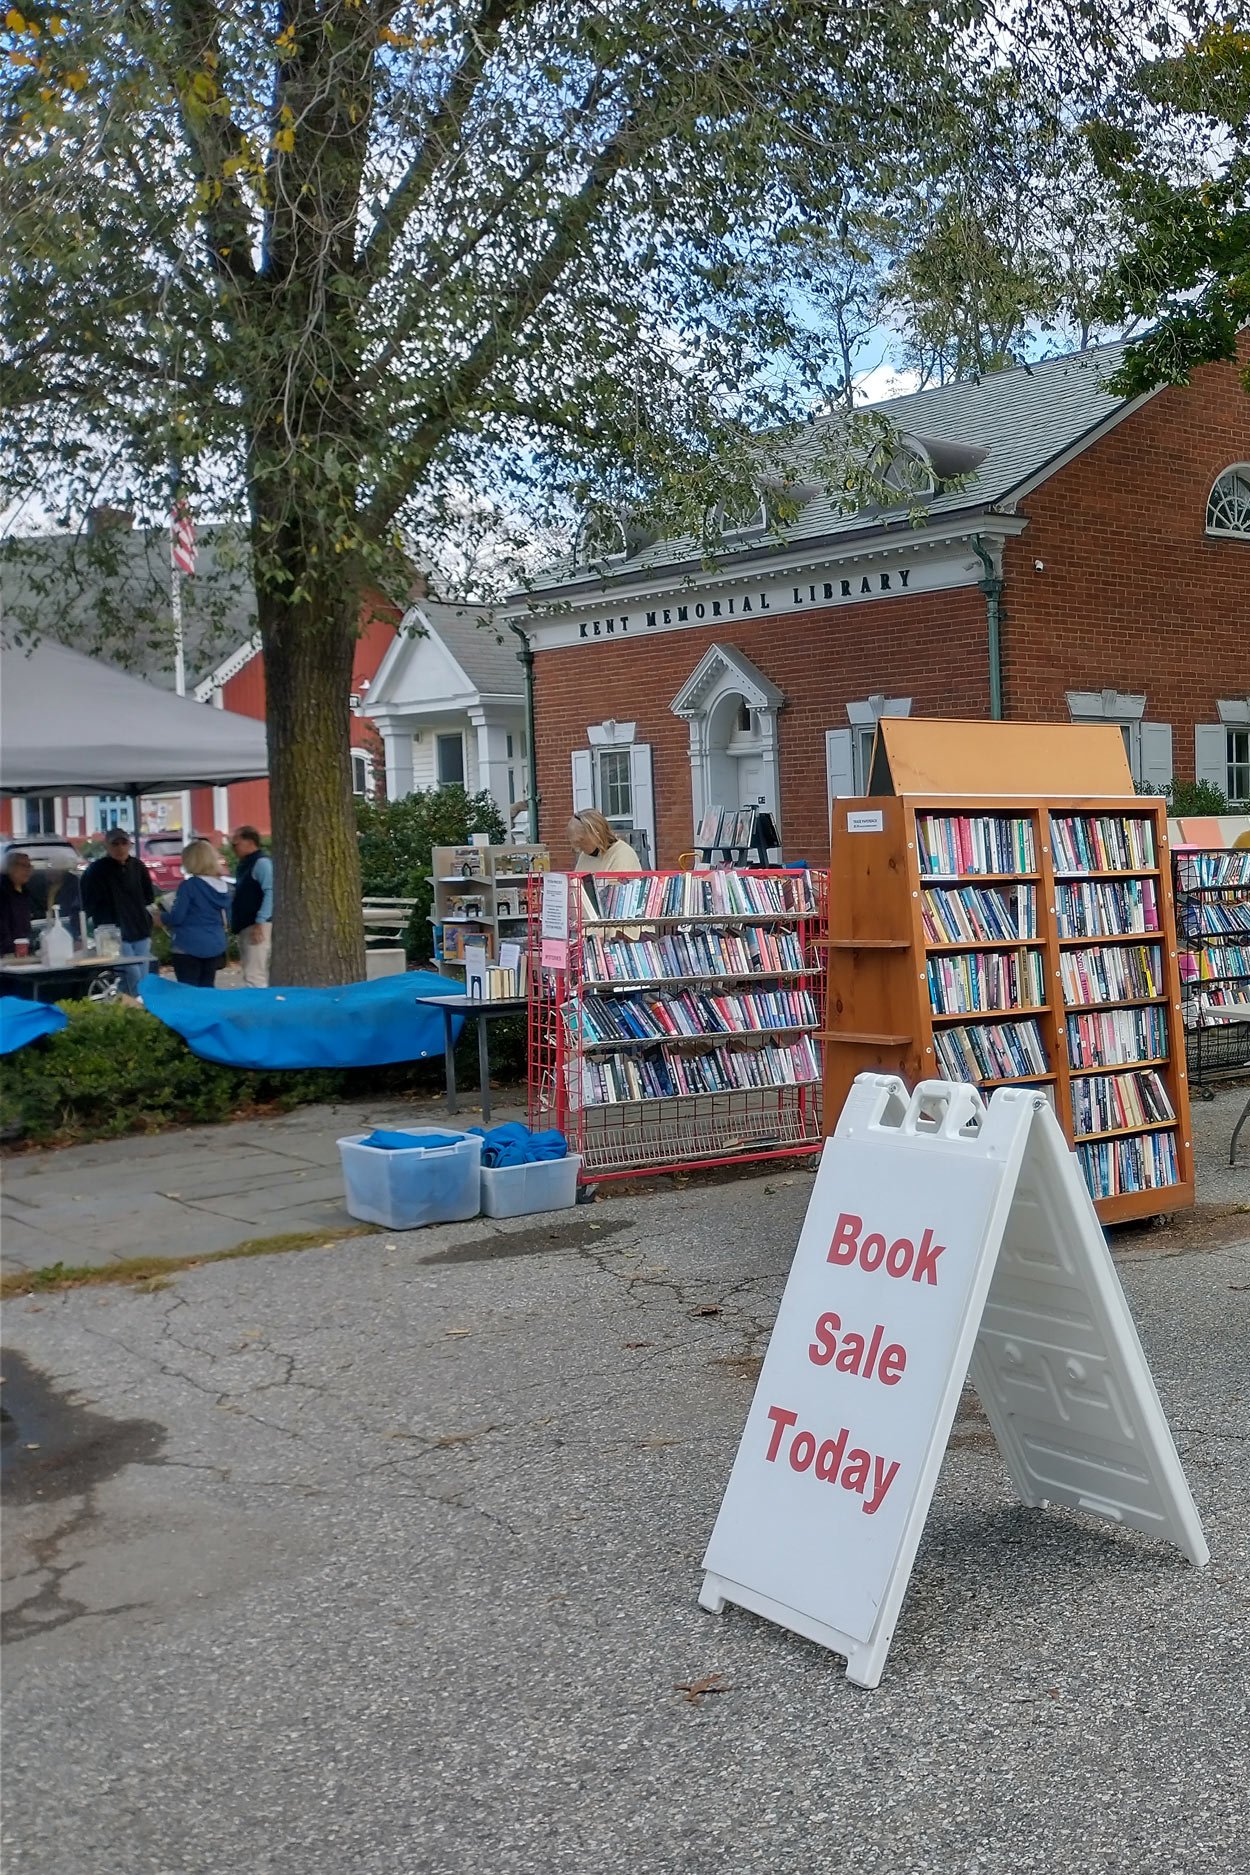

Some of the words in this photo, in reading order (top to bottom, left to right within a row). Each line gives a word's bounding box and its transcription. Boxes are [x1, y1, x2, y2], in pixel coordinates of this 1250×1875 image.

[579, 617, 629, 638] KENT
[646, 593, 770, 627] MEMORIAL
[793, 569, 911, 604] LIBRARY
[826, 1212, 946, 1286] Book
[808, 1311, 908, 1386] Sale
[766, 1405, 900, 1515] Today
